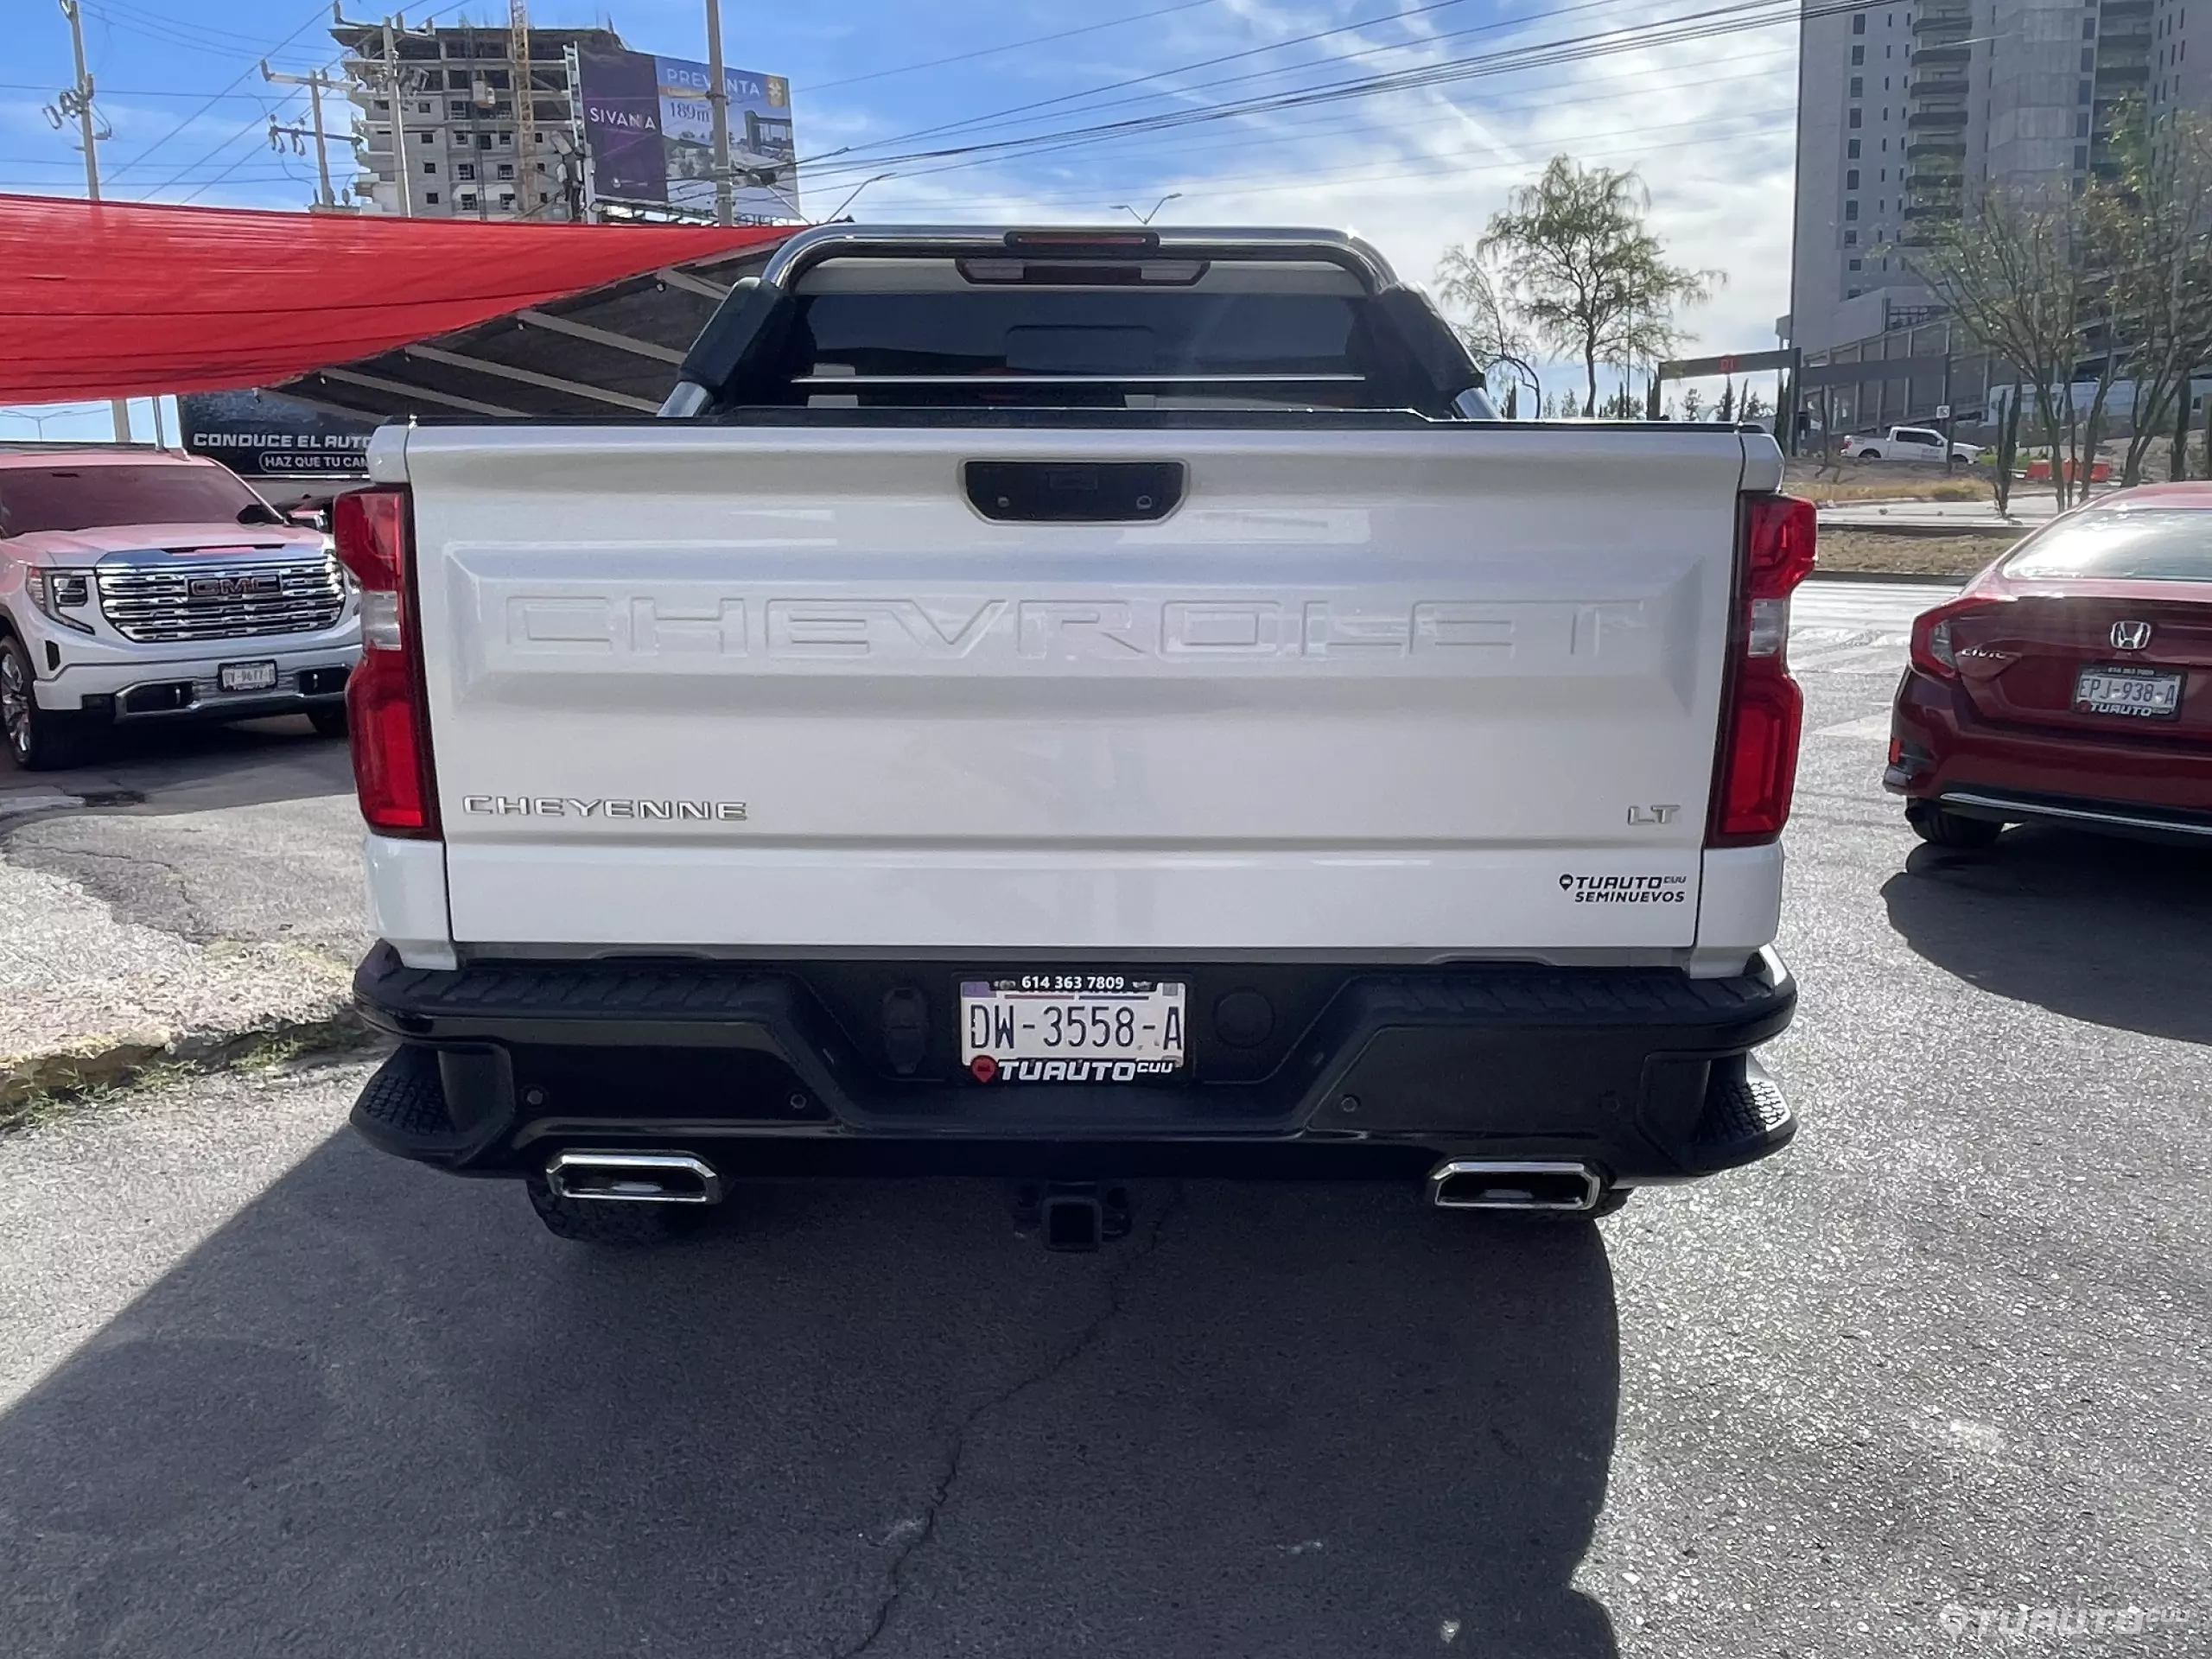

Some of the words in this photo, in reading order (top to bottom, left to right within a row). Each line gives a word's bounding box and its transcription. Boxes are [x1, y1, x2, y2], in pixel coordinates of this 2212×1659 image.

[590, 106, 656, 130] SIVANA
[193, 433, 293, 448] CONDUCE
[297, 434, 321, 448] EL
[264, 456, 292, 467] HAZ
[295, 456, 321, 467] QUE
[323, 456, 340, 467] TU
[191, 576, 278, 596] GMC
[506, 595, 1643, 660] CHEVROLET
[462, 795, 748, 821] CHEYENNE
[1627, 804, 1681, 826] LT
[1573, 891, 1686, 903] SEMINUEVOS
[1021, 976, 1051, 989] 614
[1054, 976, 1083, 988] 363
[1086, 976, 1125, 989] 7809
[969, 1003, 1183, 1052] DW-3558-A
